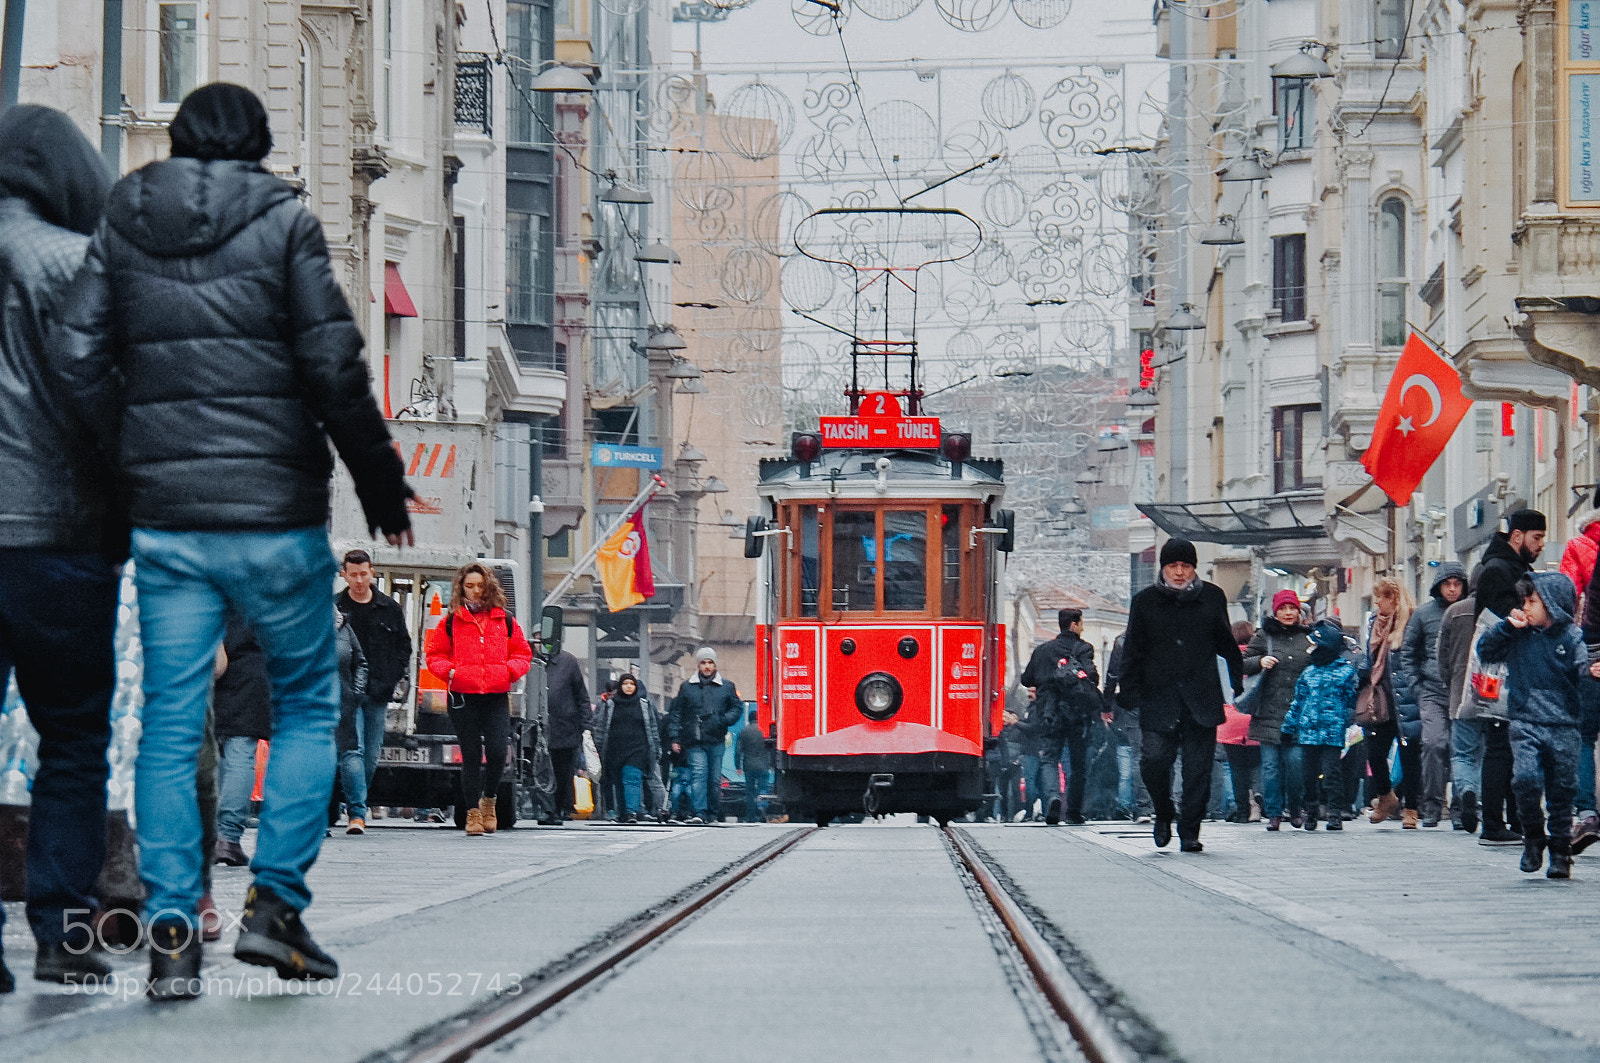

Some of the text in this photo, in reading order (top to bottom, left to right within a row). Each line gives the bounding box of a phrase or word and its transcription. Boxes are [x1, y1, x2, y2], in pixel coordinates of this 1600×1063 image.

[1579, 3, 1590, 29] kurs
[1580, 142, 1591, 167] kurs
[875, 394, 886, 414] 2
[823, 420, 869, 440] TAKSİM
[896, 418, 938, 439] TÜNEL
[613, 451, 657, 463] TURKCELL
[786, 642, 800, 659] 223
[961, 643, 976, 659] 223
